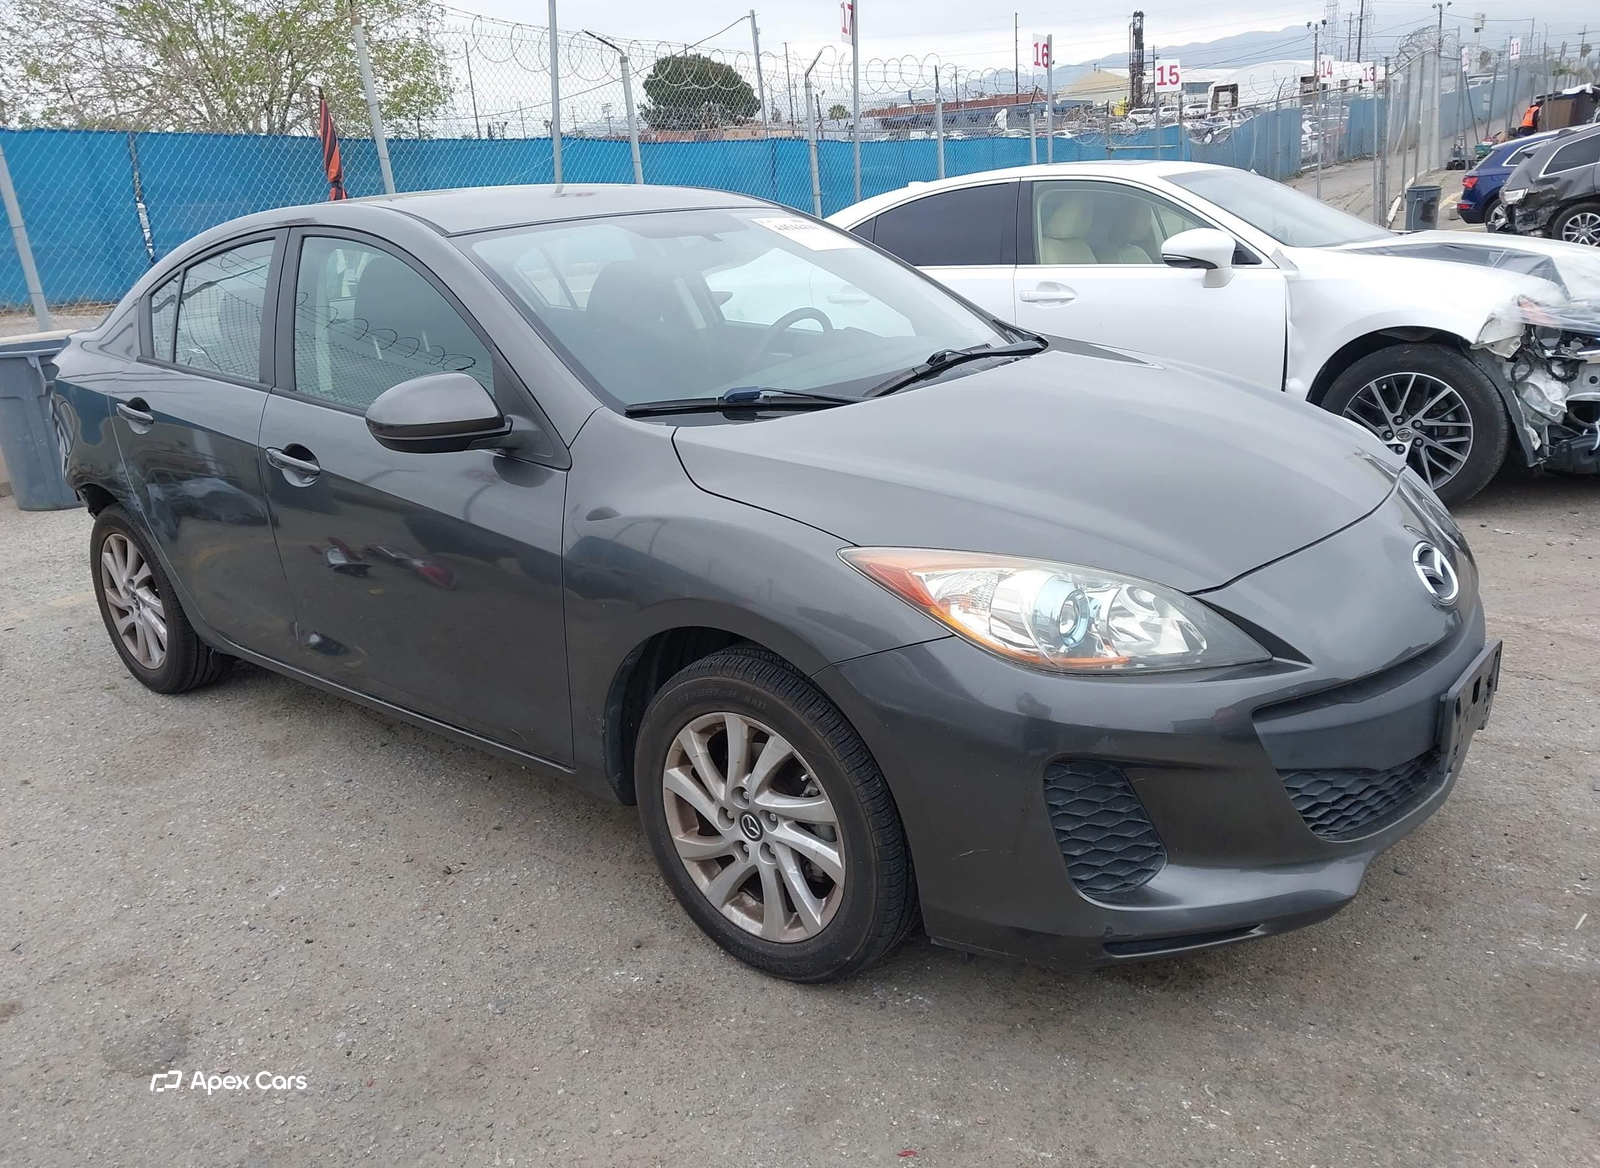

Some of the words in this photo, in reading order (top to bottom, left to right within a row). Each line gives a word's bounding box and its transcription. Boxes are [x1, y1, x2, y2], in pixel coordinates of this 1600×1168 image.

[840, 1, 854, 36] 17
[1034, 42, 1049, 68] 16
[1156, 64, 1180, 86] 15
[1321, 60, 1333, 78] 14
[1363, 66, 1376, 82] 13
[677, 687, 738, 705] STREET-H
